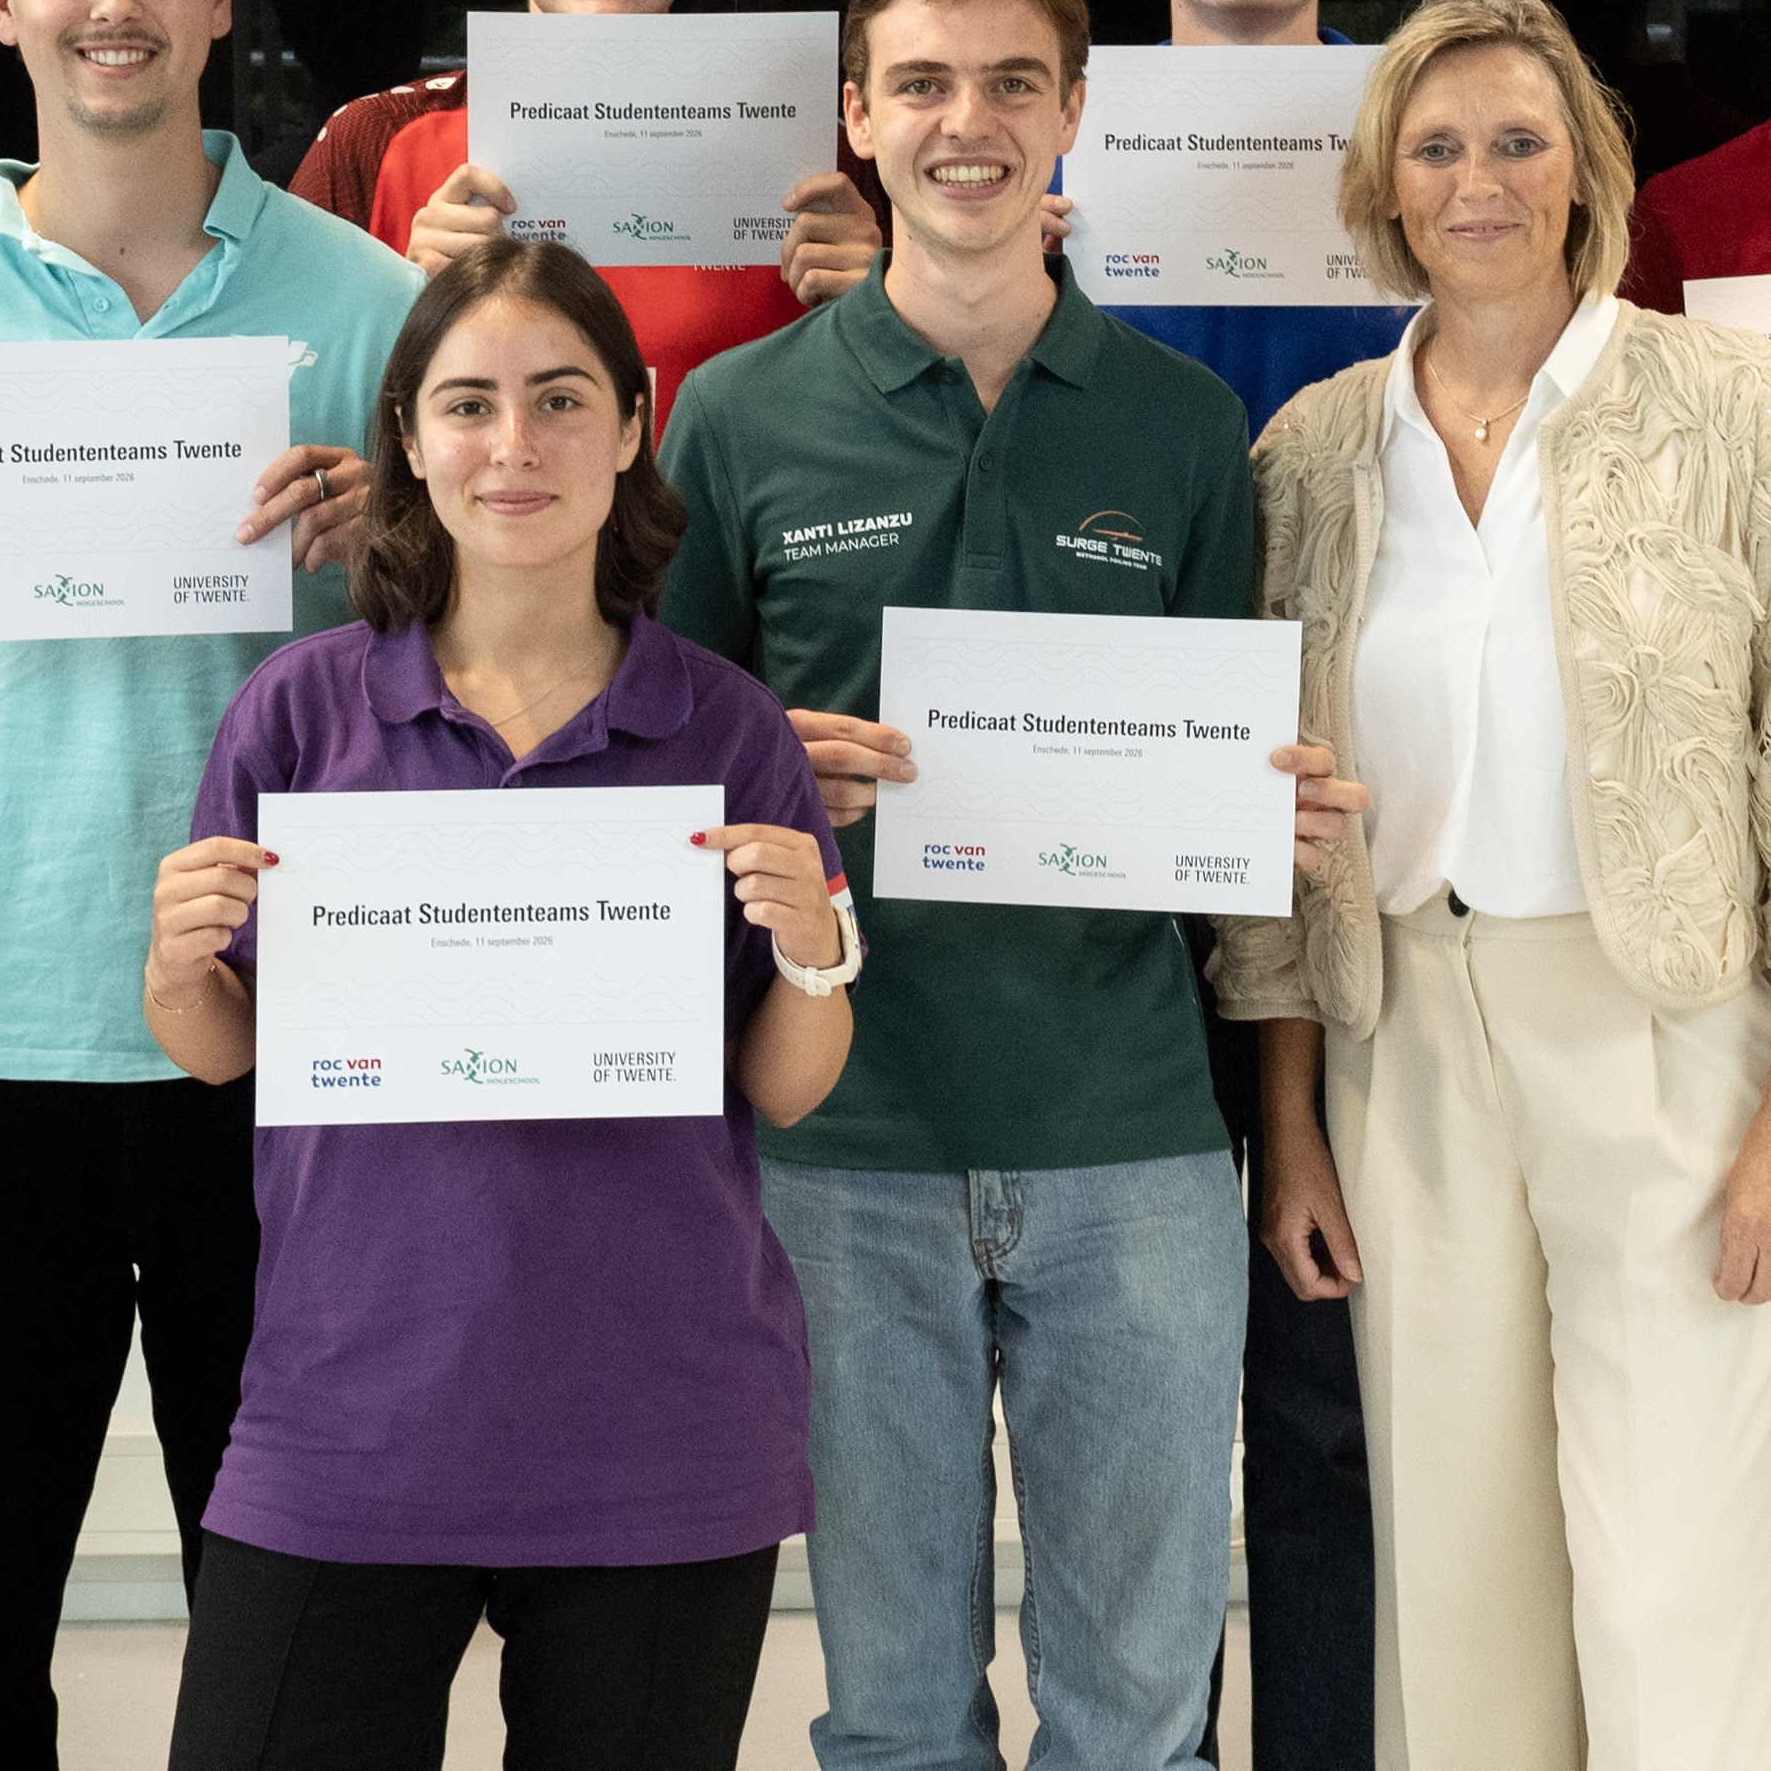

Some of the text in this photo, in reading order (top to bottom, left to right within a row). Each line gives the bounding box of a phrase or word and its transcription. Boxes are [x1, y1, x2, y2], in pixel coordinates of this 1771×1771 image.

[510, 101, 797, 120] Predicaat Studententeams Twente
[640, 130, 648, 138] 11
[1104, 133, 1182, 152] Predicaat
[1187, 133, 1323, 152] Studententeams
[1232, 161, 1240, 170] 11
[511, 219, 566, 229] roc van
[612, 213, 674, 240] SAXION
[733, 229, 789, 240] OF TWEN
[1105, 254, 1160, 264] roc van
[1206, 248, 1267, 277] SAXION
[1104, 264, 1160, 277] twente
[1327, 267, 1341, 278] OF
[10, 441, 168, 464] Studententeams
[173, 439, 242, 460] Twente
[63, 474, 73, 484] 11
[782, 512, 913, 545] XANTI LIZANZU
[784, 533, 900, 562] TEAM MANAGER
[1055, 534, 1163, 567] SURGE TWENTE
[173, 574, 250, 589] UNIVERSITY
[34, 574, 105, 607] SAXION
[173, 589, 251, 604] OF TWENTE.
[928, 709, 1251, 741] Predicaat Studententeams Twente
[1032, 744, 1070, 756] Enschede,
[1072, 746, 1082, 756] 11
[1083, 747, 1124, 759] september
[924, 843, 986, 857] roc van
[922, 856, 986, 872] twente
[1038, 843, 1107, 876] SAXION
[1175, 854, 1251, 871] UNIVERSITY
[1174, 869, 1251, 885] OF TWENTE.
[312, 899, 671, 927] Predicaat Studententeams Twente
[430, 935, 554, 948] Enschede, 11 september 2026
[312, 1058, 382, 1071] roc van
[441, 1048, 518, 1084] SAXION
[593, 1051, 676, 1068] UNIVERSITY
[311, 1071, 382, 1088] twente
[486, 1077, 540, 1085] HOGESCHOOL
[593, 1066, 677, 1083] OF TWENTE.
